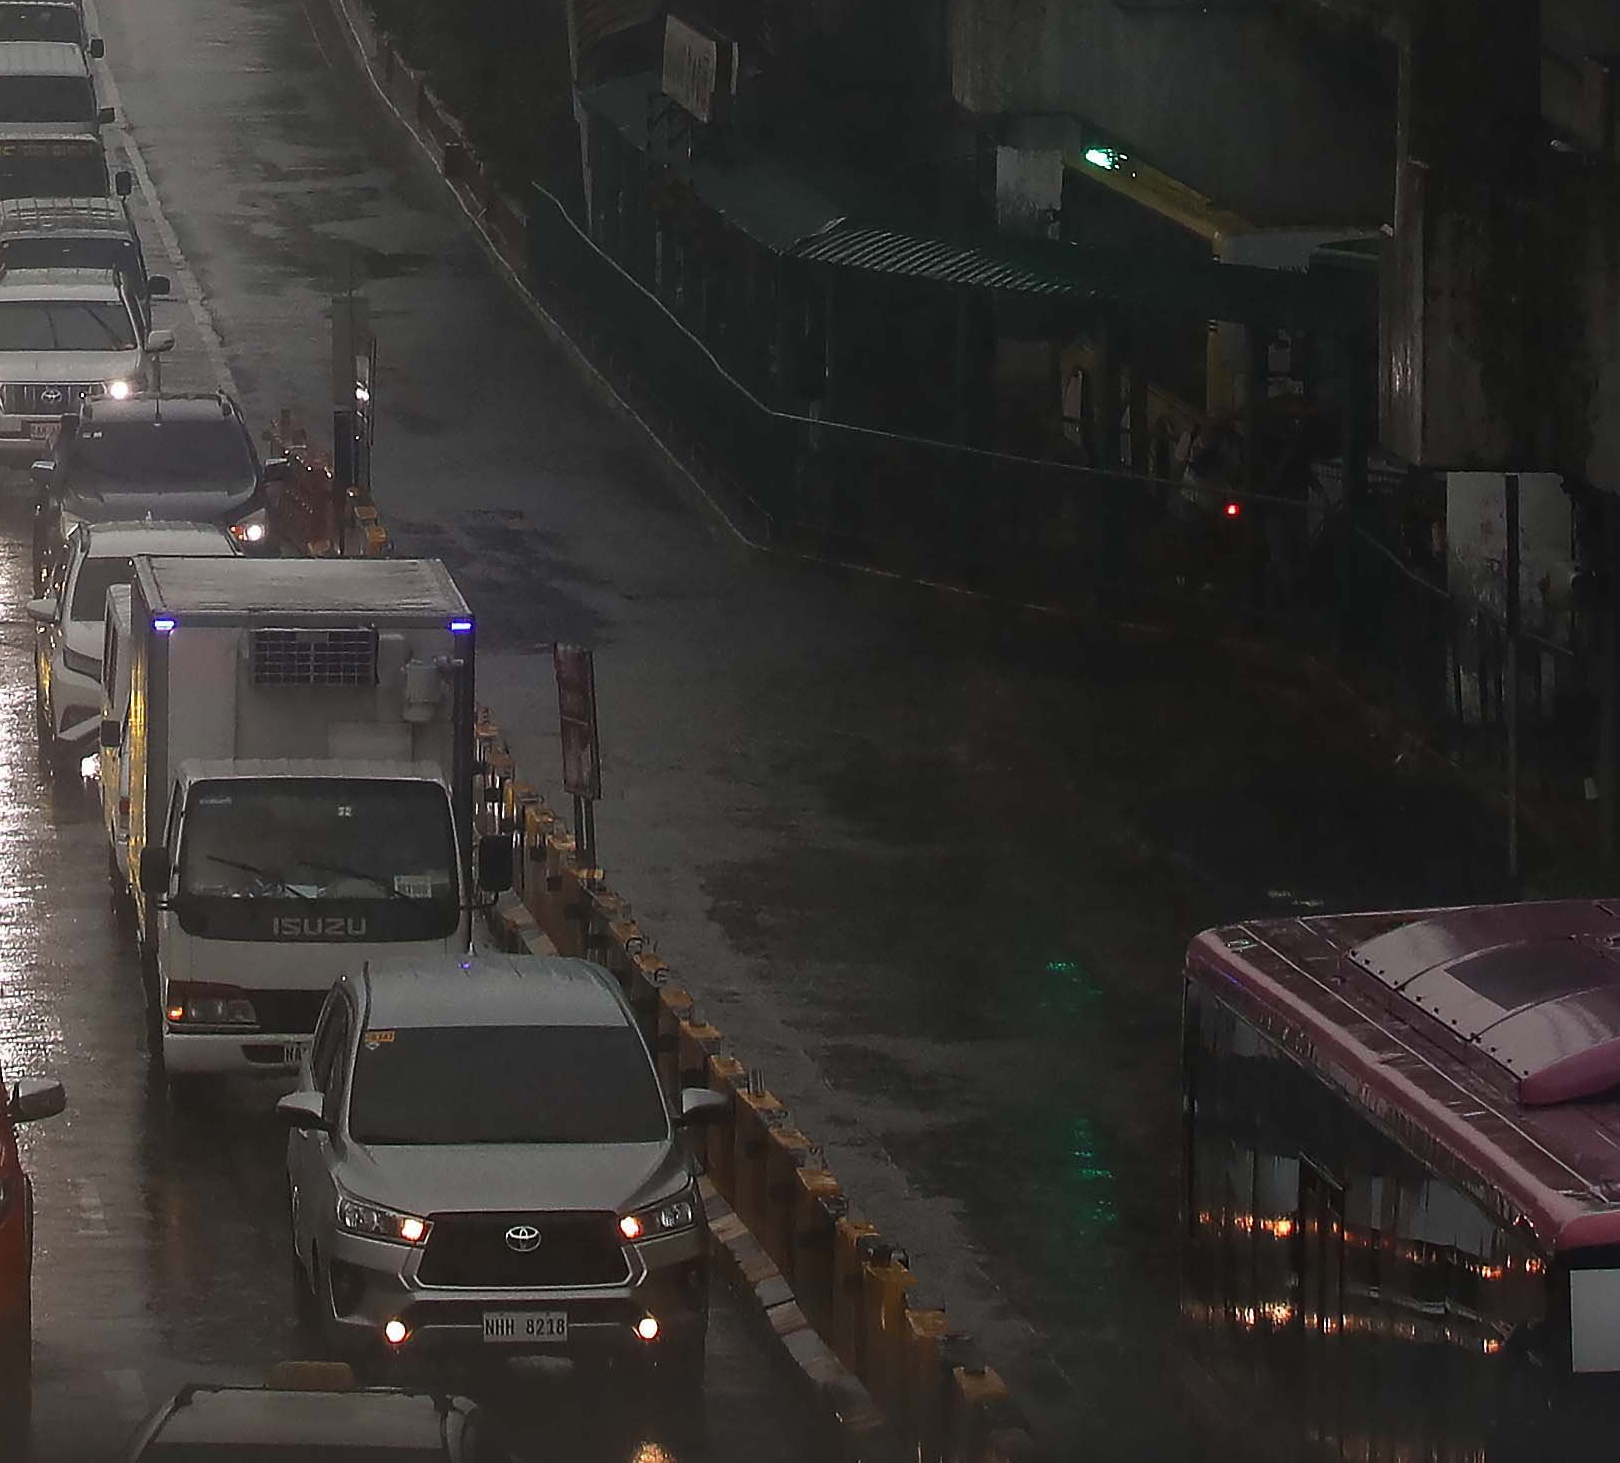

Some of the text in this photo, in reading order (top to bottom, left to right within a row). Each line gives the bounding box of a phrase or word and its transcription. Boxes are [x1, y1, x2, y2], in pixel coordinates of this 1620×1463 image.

[272, 917, 367, 936] ISUZU
[484, 1317, 566, 1335] NHH 8218
